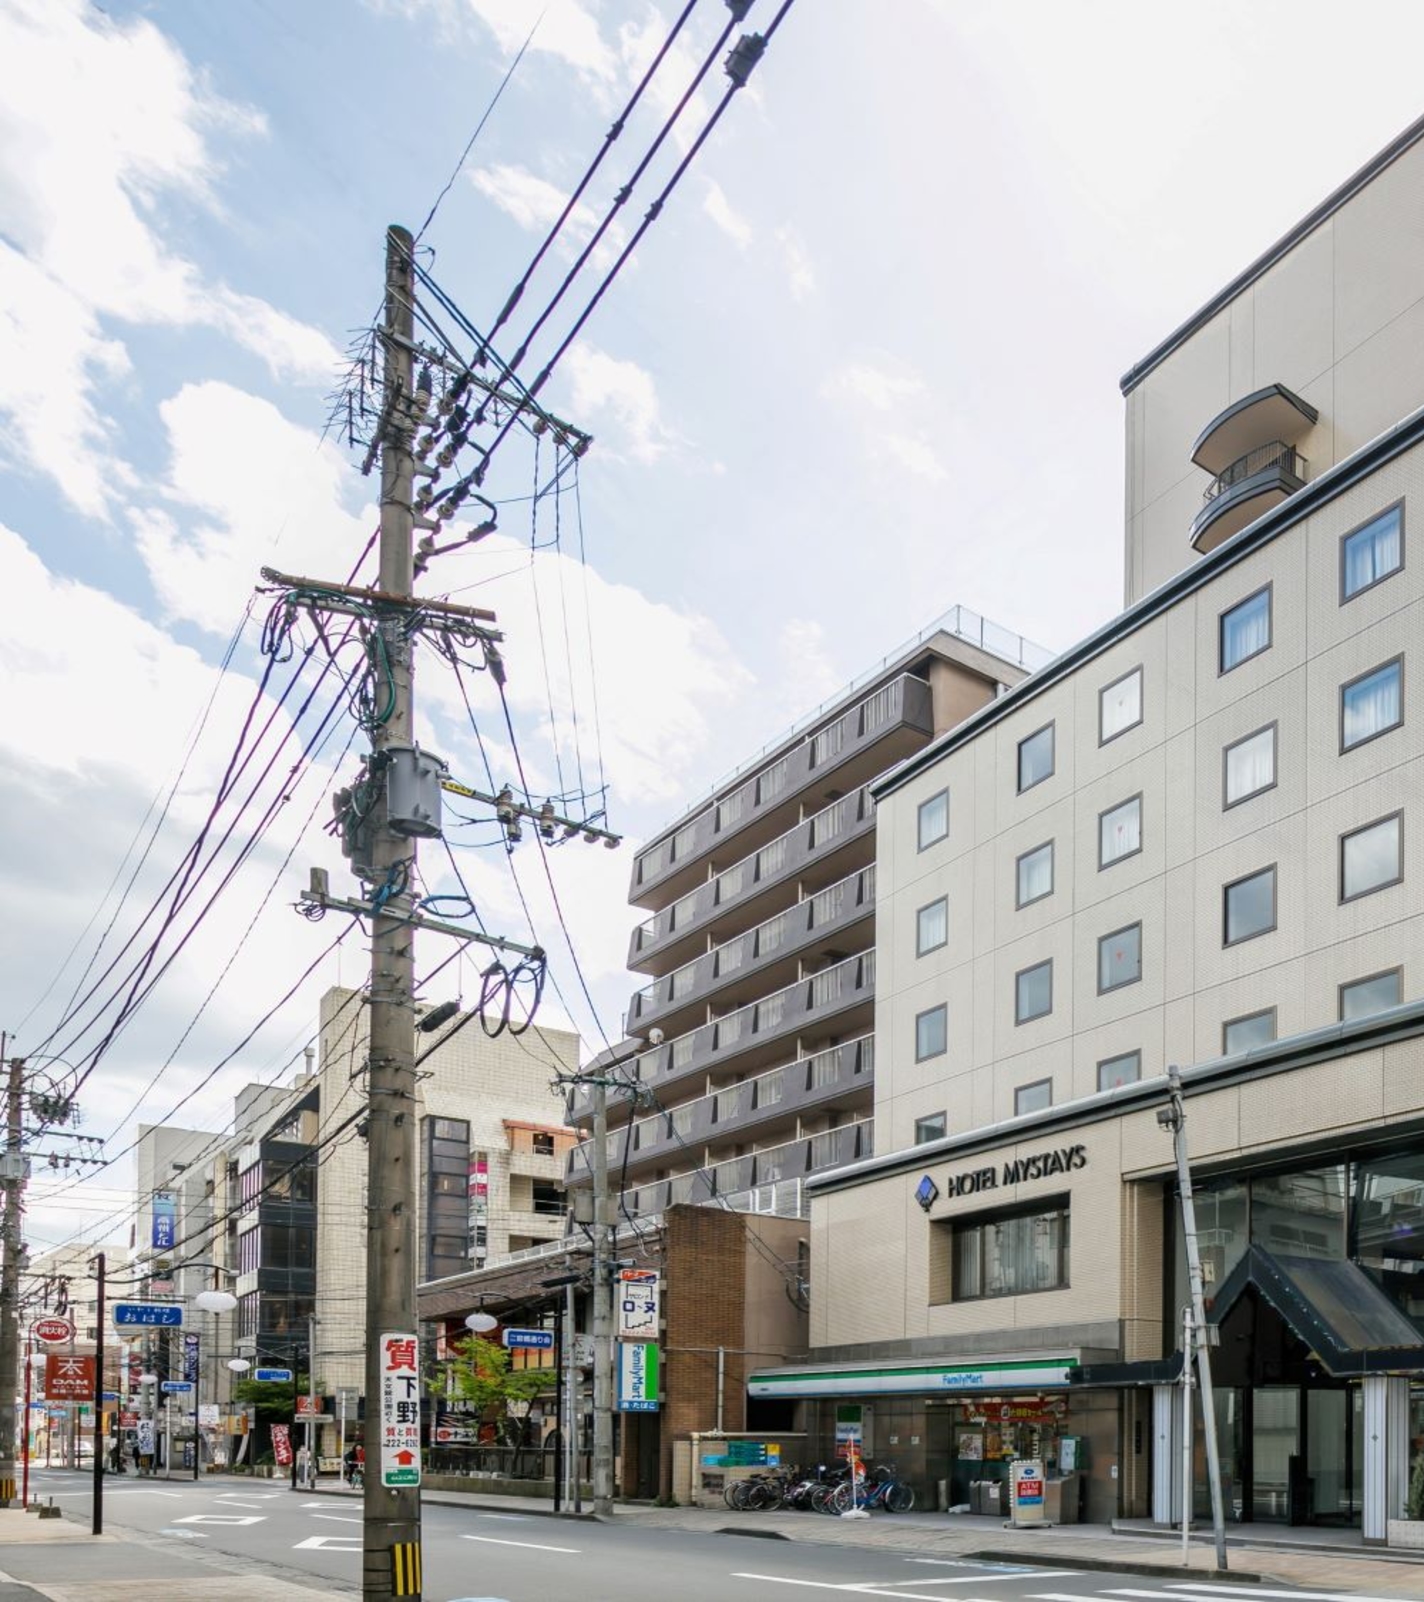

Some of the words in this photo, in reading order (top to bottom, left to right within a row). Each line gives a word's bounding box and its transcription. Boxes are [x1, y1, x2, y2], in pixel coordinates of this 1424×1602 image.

[948, 1167, 998, 1198] HOTEL
[1002, 1144, 1086, 1186] MYSTAYS
[39, 1325, 67, 1335] 消火栓
[386, 1339, 416, 1372] 質
[629, 1344, 644, 1399] FamilyMart
[396, 1375, 418, 1424] 下野
[943, 1374, 984, 1386] FamilyMart
